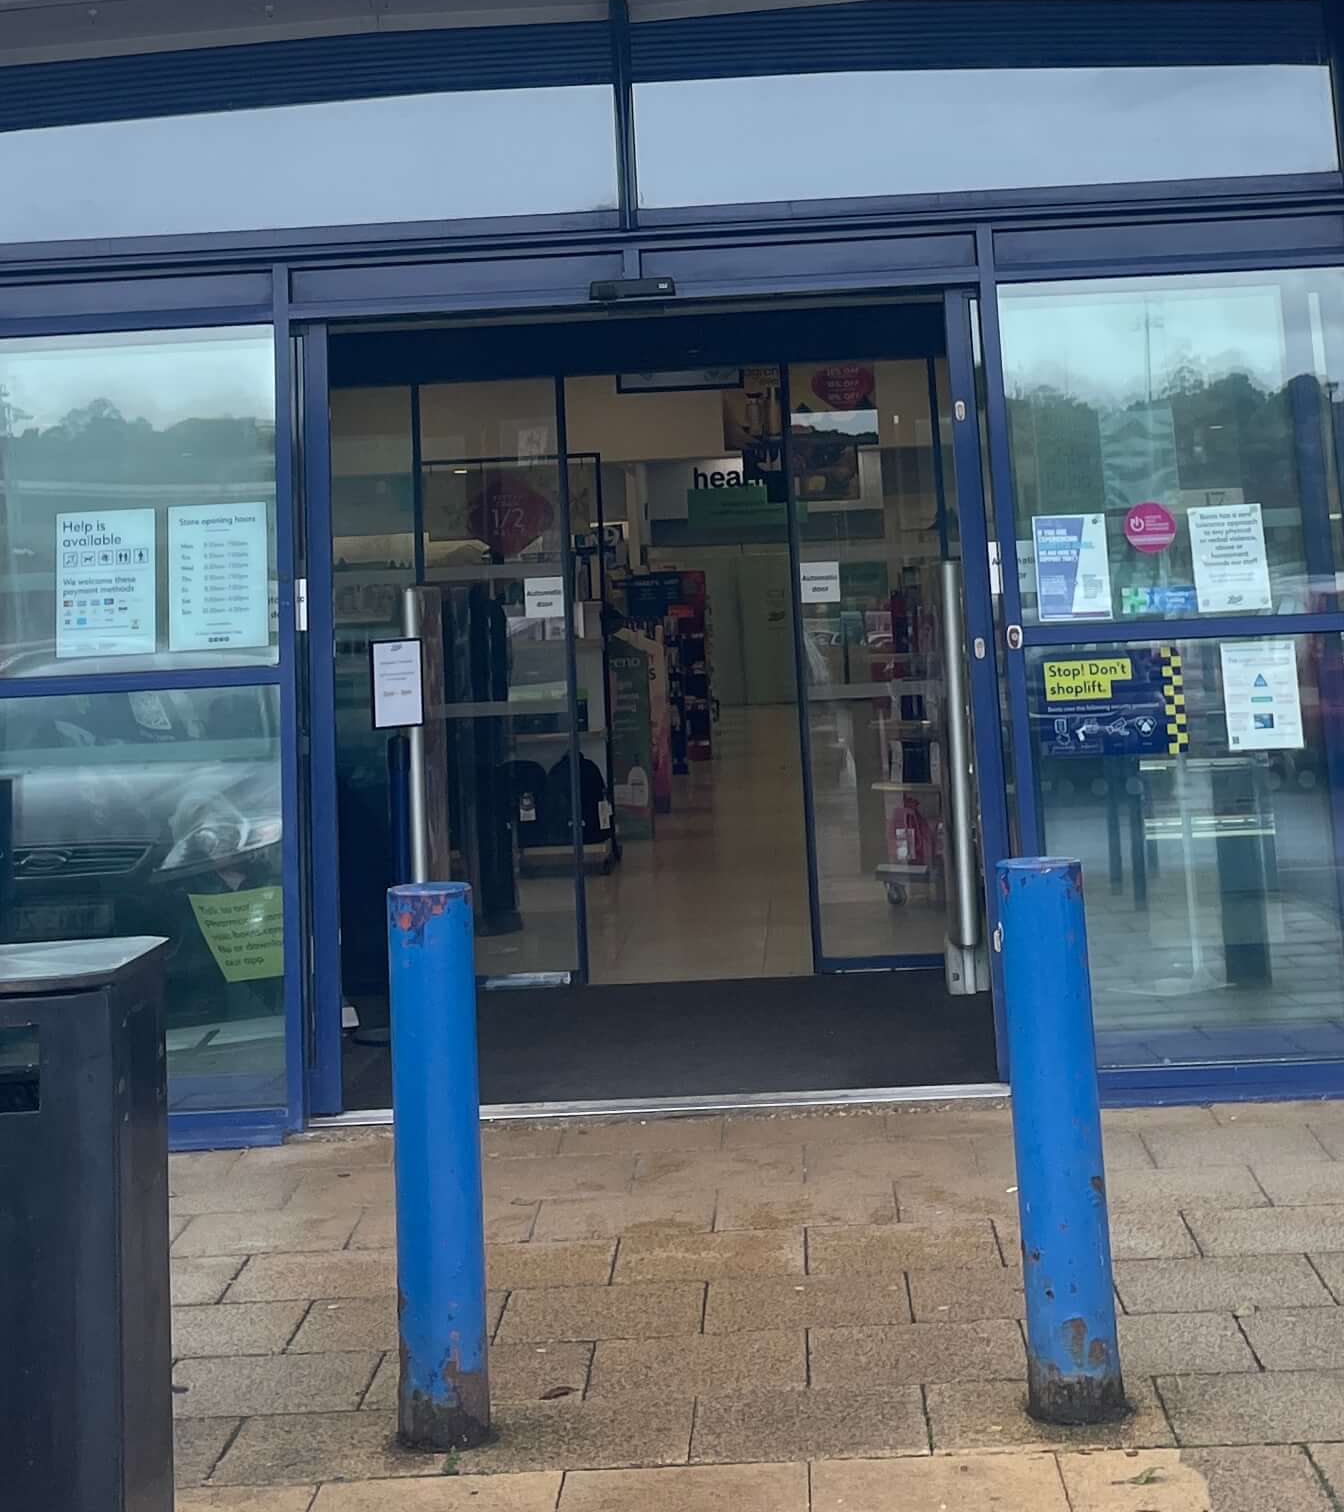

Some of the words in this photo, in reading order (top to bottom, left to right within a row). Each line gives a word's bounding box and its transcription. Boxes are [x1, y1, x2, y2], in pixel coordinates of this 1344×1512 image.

[62, 520, 93, 535] Help
[97, 520, 106, 532] is
[62, 533, 122, 548] available
[1049, 664, 1085, 680] Stop!
[1089, 662, 1127, 676] Don't
